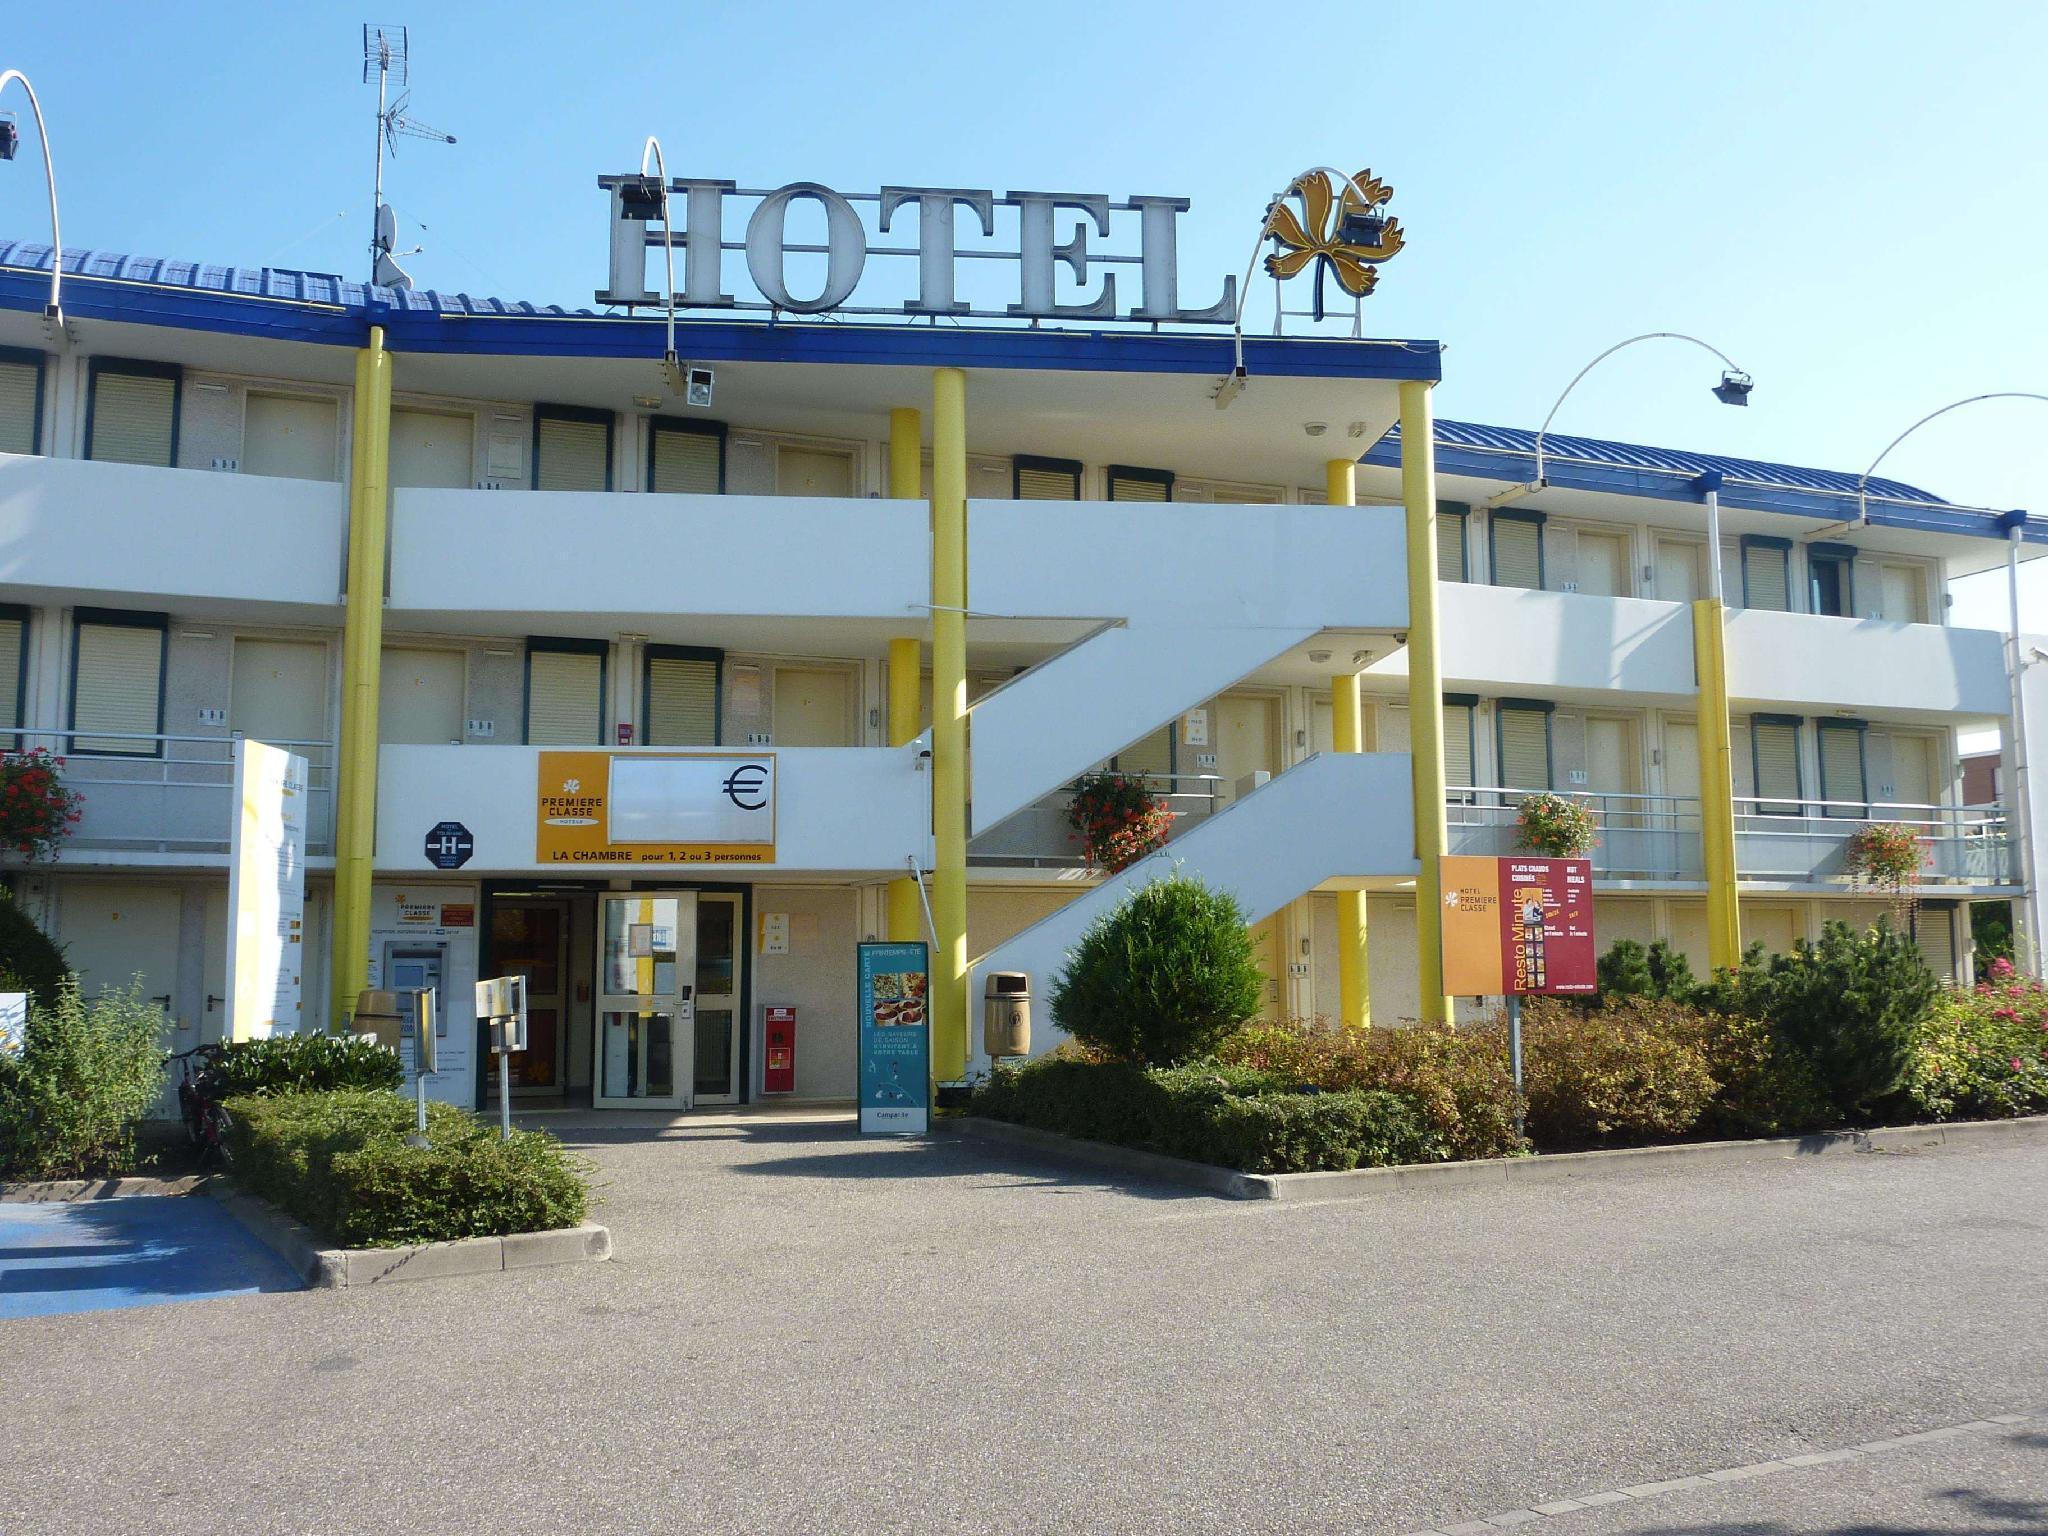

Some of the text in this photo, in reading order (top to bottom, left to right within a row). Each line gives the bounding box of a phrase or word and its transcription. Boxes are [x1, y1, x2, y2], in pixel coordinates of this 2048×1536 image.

[594, 175, 1237, 325] HOTEL
[722, 764, 768, 811] €
[542, 797, 602, 807] PREMIERE
[549, 807, 593, 816] CLASSE
[441, 836, 457, 854] H
[553, 851, 569, 860] LA
[573, 851, 633, 860] CHAMBRE
[641, 854, 664, 862] pour
[668, 851, 676, 861] 1,
[680, 852, 686, 860] 2
[705, 852, 711, 860] 3
[715, 853, 762, 861] personnes
[1460, 896, 1497, 904] PREMIERE
[1460, 904, 1487, 912] CLASSE
[1511, 888, 1526, 991] Resto Minute
